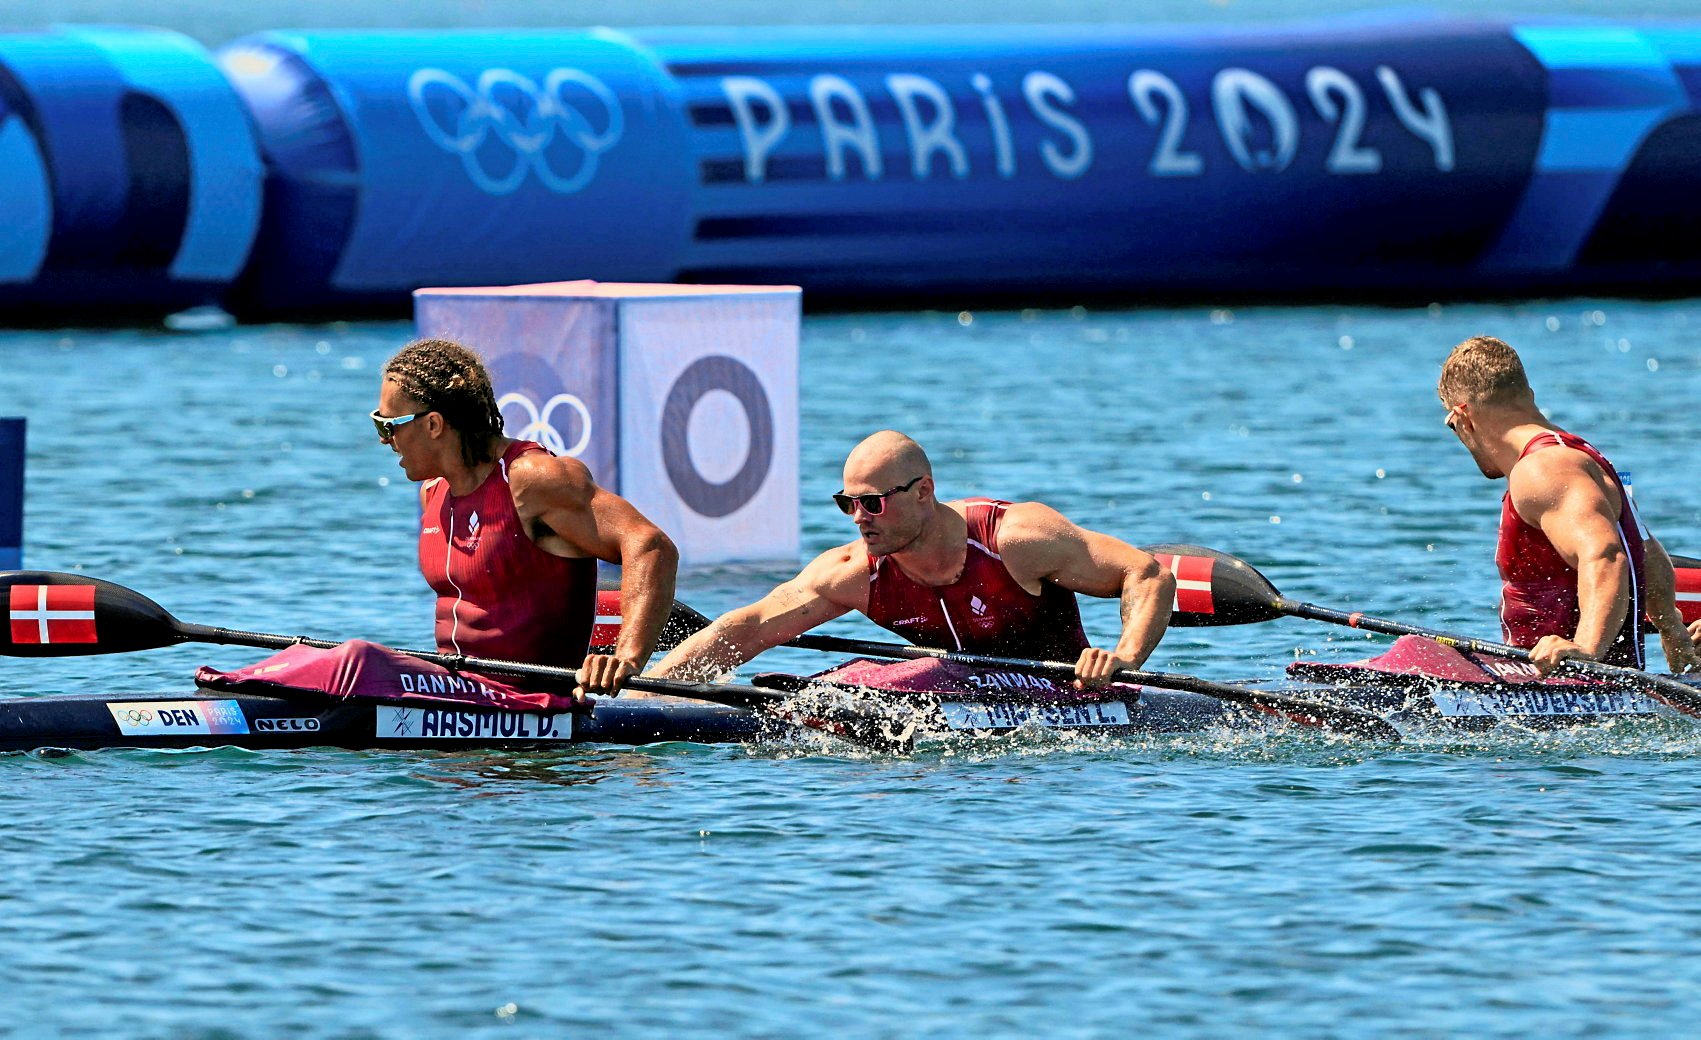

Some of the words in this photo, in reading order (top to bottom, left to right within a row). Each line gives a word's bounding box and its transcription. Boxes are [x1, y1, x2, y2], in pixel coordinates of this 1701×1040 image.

[1128, 65, 1455, 176] 2024
[157, 709, 199, 727] DEN
[257, 719, 319, 731] NELO
[422, 709, 529, 737] AASMUL
